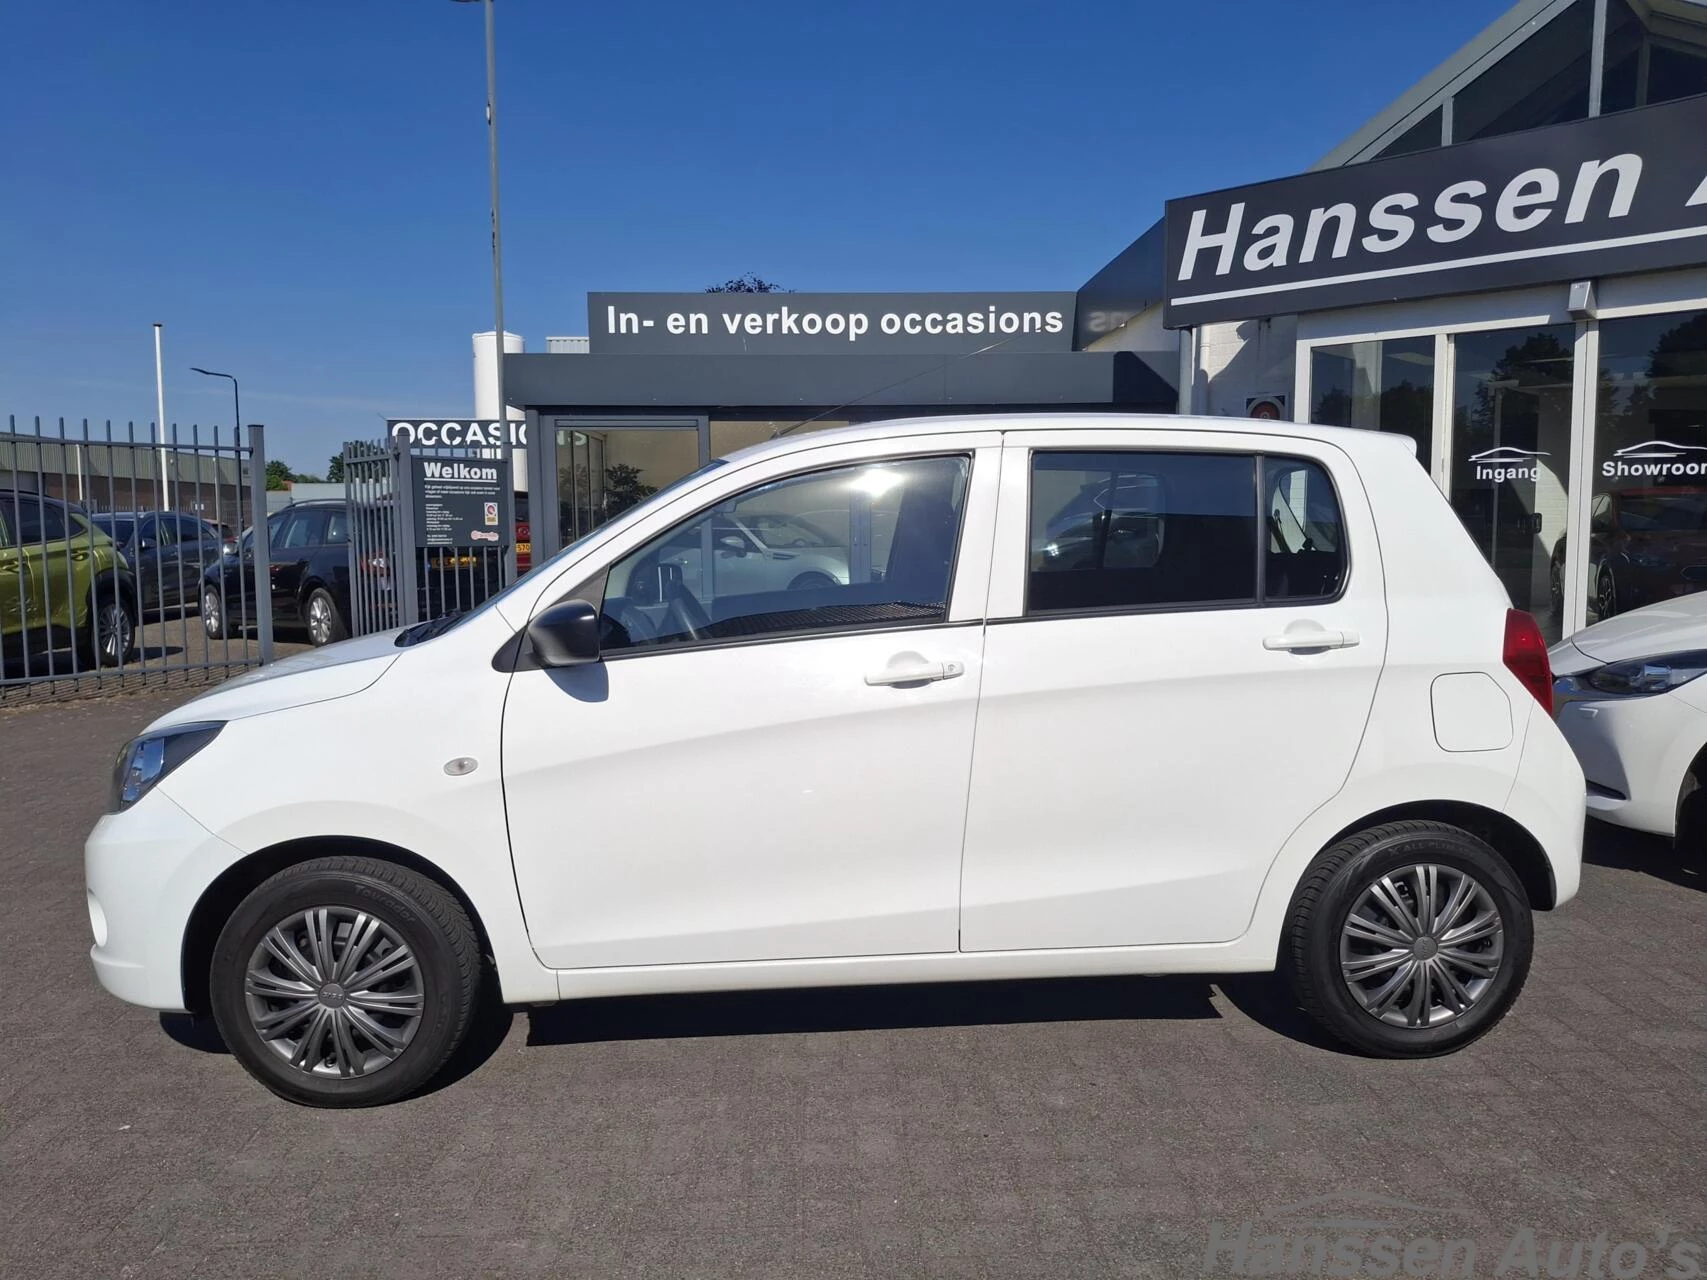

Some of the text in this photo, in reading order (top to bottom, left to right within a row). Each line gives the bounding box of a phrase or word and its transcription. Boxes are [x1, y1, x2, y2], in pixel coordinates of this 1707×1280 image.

[1177, 153, 1643, 281] Hanssen
[607, 305, 655, 334] In-
[666, 312, 709, 335] en
[721, 305, 869, 342] verkoop
[880, 305, 1063, 335] occasions
[423, 461, 498, 479] Welkom
[1476, 465, 1542, 483] Ingang
